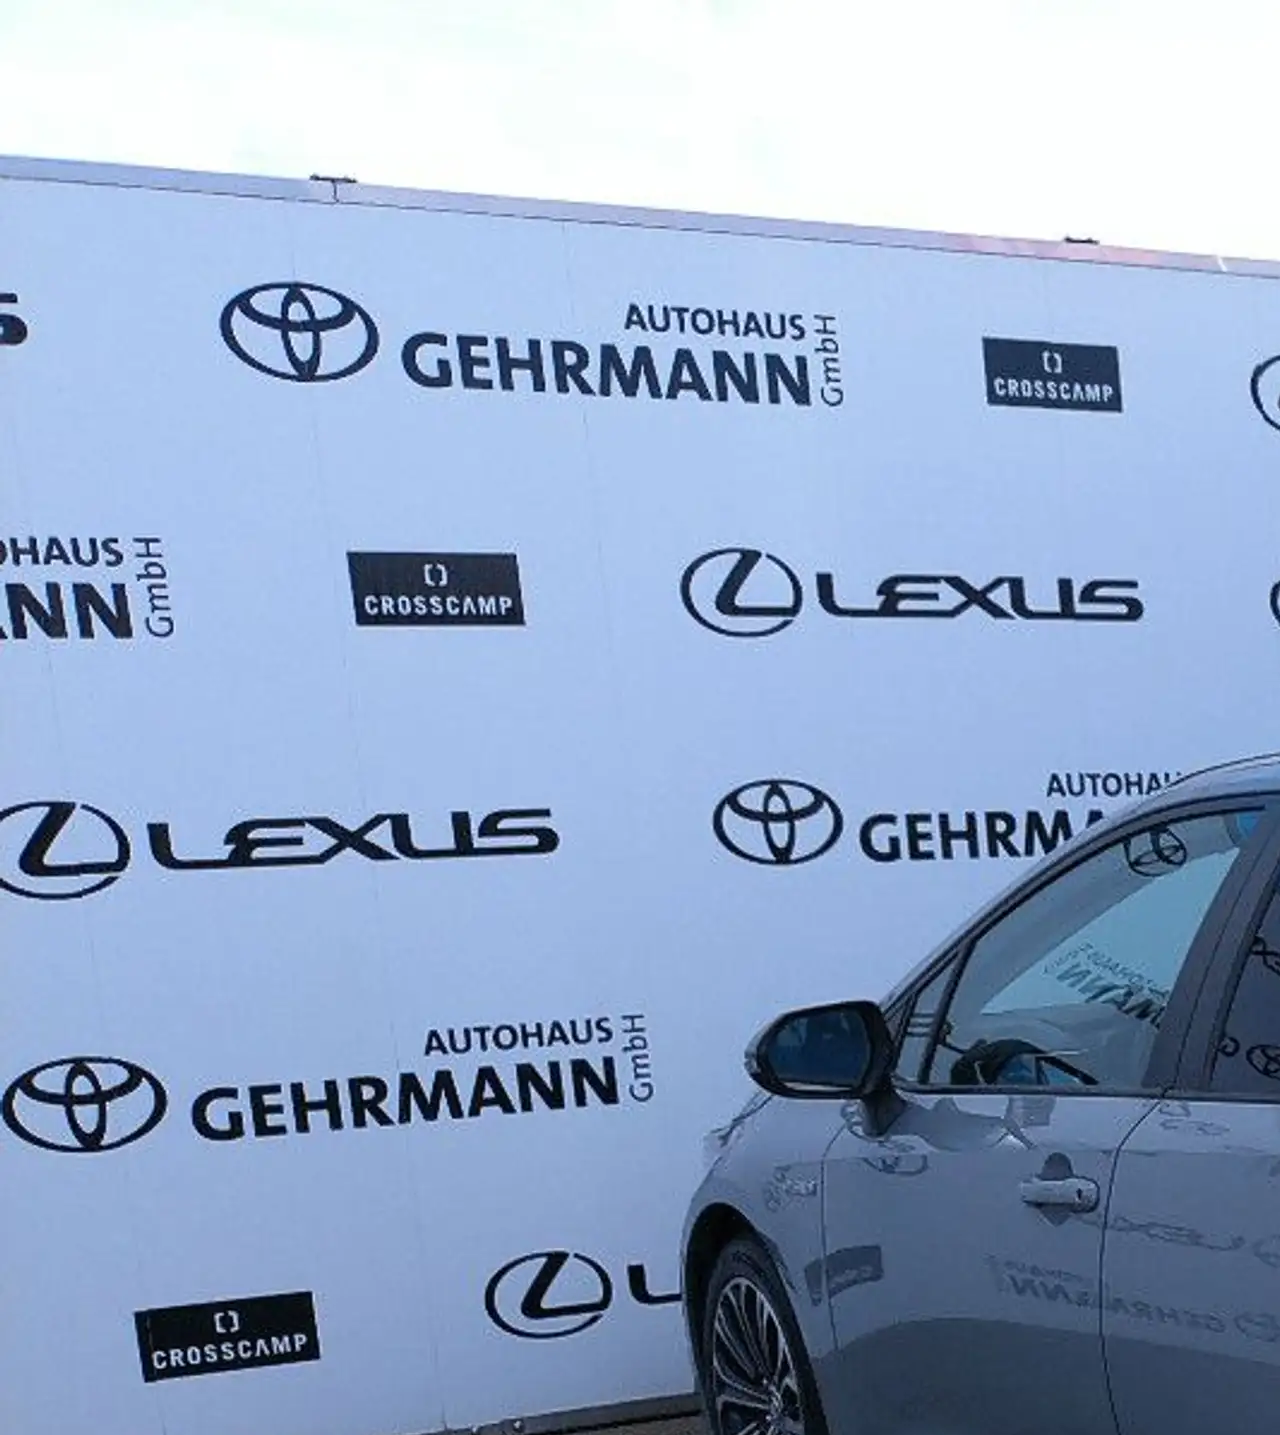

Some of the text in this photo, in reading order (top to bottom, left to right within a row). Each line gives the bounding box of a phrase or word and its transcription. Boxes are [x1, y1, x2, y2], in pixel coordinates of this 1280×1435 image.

[624, 303, 806, 341] AUTOHAUS
[400, 332, 812, 407] GEHRMANN
[813, 314, 844, 407] GmbH
[994, 376, 1114, 404] CROSSCAMP
[133, 537, 174, 639] GmbH
[364, 595, 513, 617] CROSSCAMP
[815, 572, 1144, 622] LEXUS
[1046, 771, 1181, 798] AUTOHA
[146, 808, 560, 870] LEXUS
[859, 809, 1104, 863] GEHRM
[424, 1016, 613, 1056] AUTOHAUS
[621, 1014, 654, 1103] GmbH
[191, 1056, 620, 1141] GEHRMANN
[152, 1334, 309, 1371] CROSSCAMP
